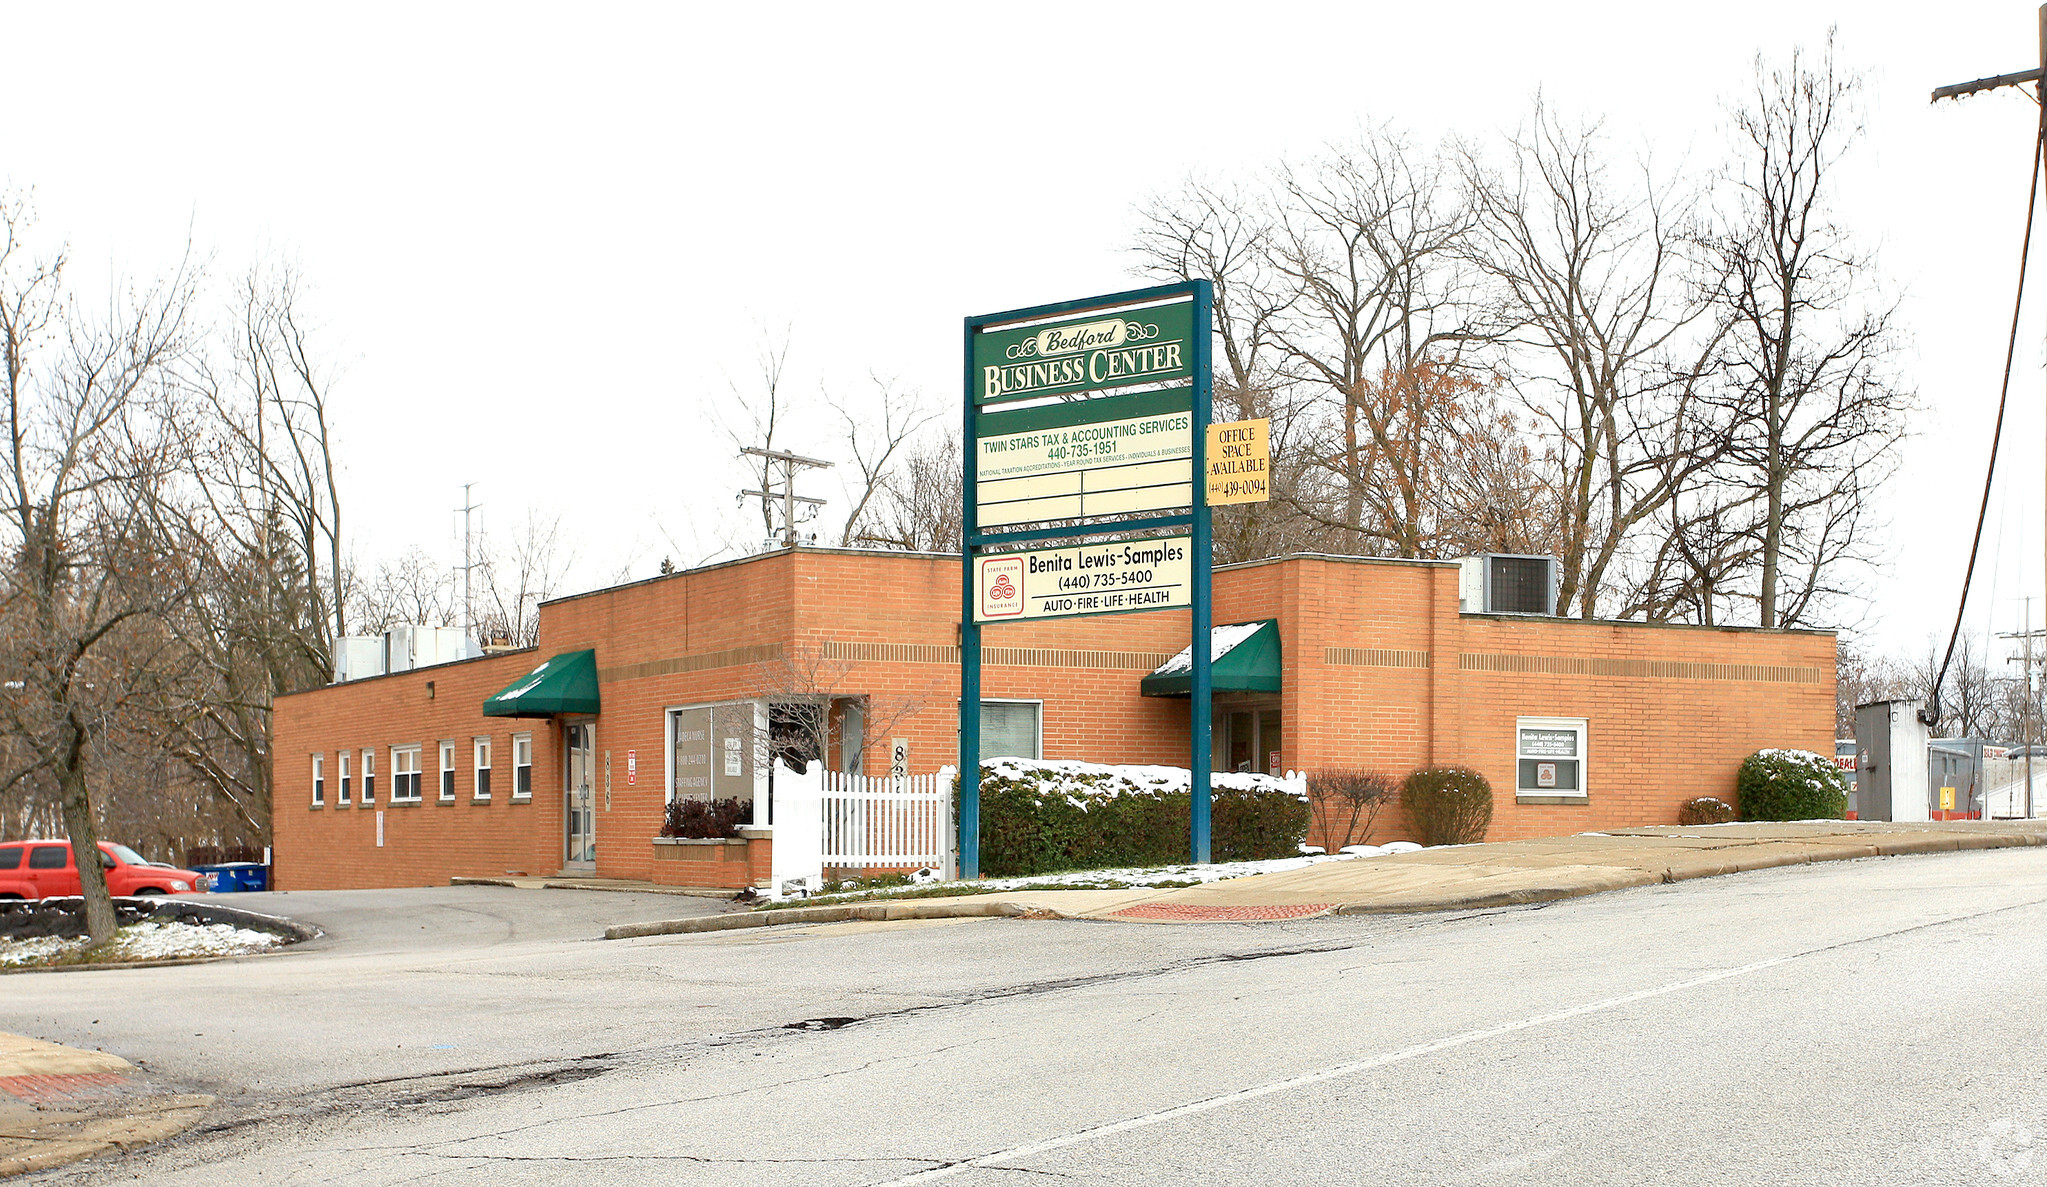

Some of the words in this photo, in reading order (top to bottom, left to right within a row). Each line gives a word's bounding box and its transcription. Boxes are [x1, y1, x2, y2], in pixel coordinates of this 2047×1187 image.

[1046, 324, 1117, 352] Bedford
[983, 357, 1085, 399] BUSINESS
[1089, 344, 1183, 383] CENTER
[984, 440, 1007, 454] TWIN
[1009, 436, 1040, 451] STARS
[1041, 433, 1060, 447] TAX
[1061, 432, 1069, 445] &
[1071, 423, 1137, 443] ACCOUNTING
[1139, 417, 1189, 435] SERVICES
[1219, 427, 1256, 444] OFFICE
[1048, 440, 1117, 460] 440-735-1951
[1222, 443, 1252, 459] SPACE
[979, 469, 1001, 477] NATIONAL
[1001, 466, 1023, 475] TAXATION
[1023, 461, 1061, 472] ACCREDITATIONS
[1063, 459, 1076, 467] YEAR
[1076, 458, 1093, 466] ROUND
[1093, 456, 1102, 464] TAX
[1102, 454, 1125, 463] SERVICES
[1127, 450, 1156, 460] INDIVIDUALS
[1161, 446, 1190, 456] BUSINESSES
[1210, 458, 1265, 476] AVAILABLE
[1223, 479, 1266, 498] 439-0094
[1030, 553, 1072, 574] Benita
[1079, 541, 1183, 569] Lewis-Samples
[1058, 574, 1090, 591] (440)
[1094, 569, 1153, 587] 735-5400
